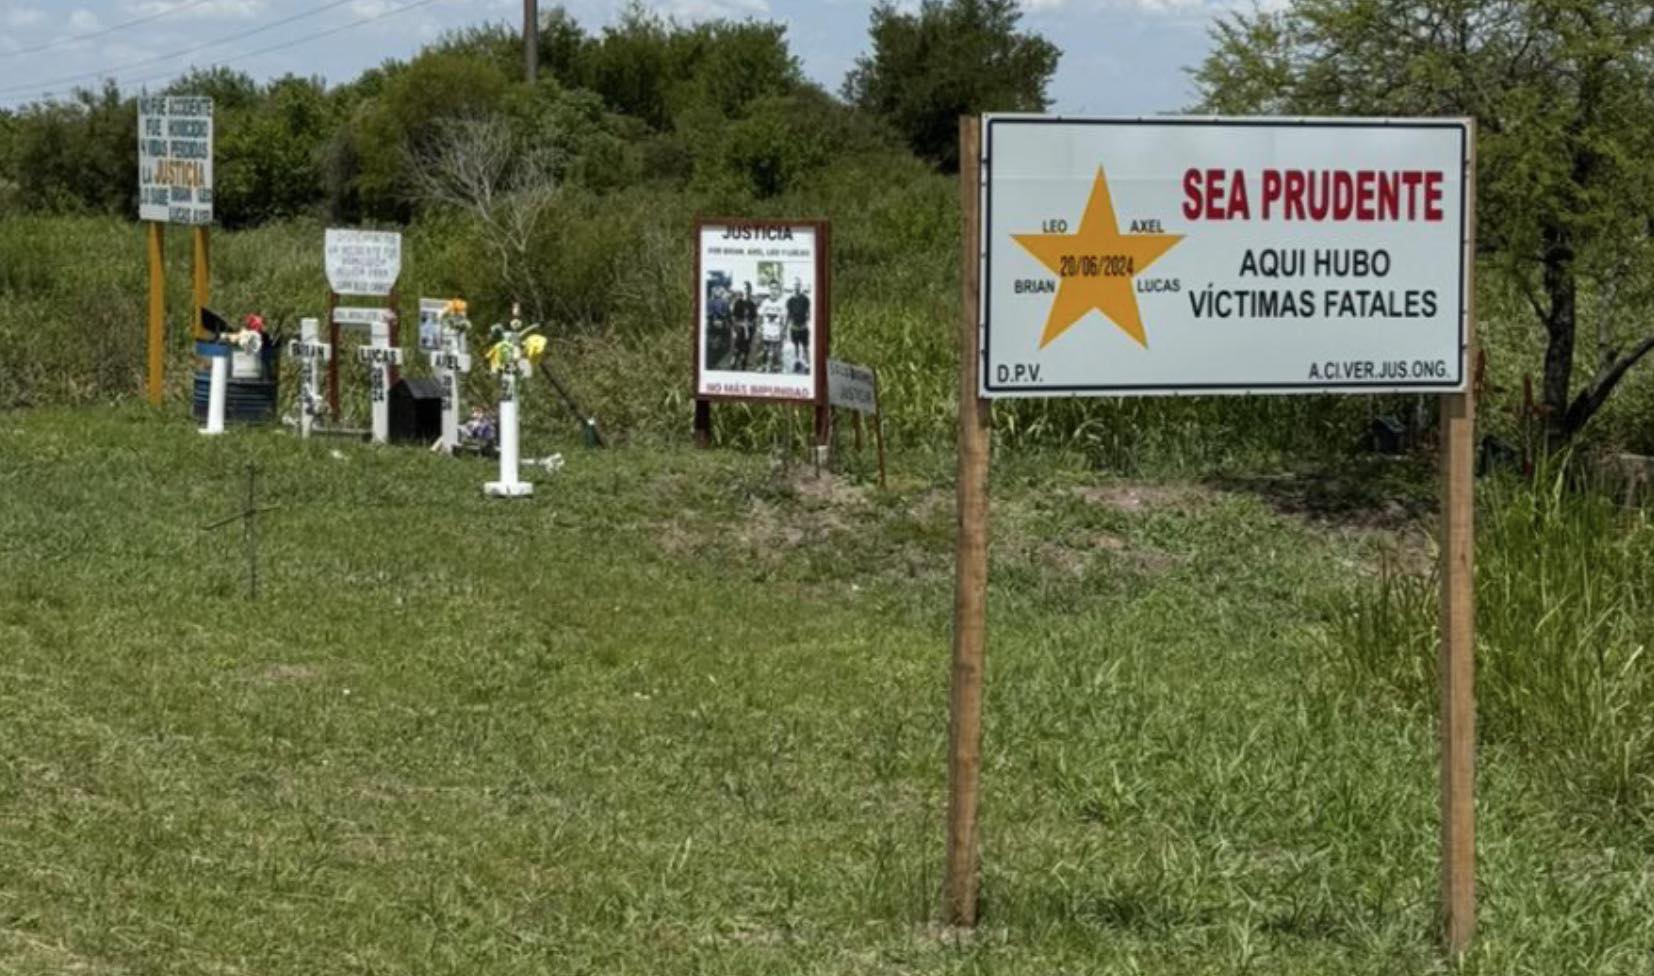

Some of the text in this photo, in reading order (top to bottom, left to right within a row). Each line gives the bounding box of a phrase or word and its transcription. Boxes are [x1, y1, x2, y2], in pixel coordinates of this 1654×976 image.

[154, 160, 206, 186] JUSTICIA
[1181, 167, 1444, 222] SEA PRUDENTE
[722, 225, 794, 241] JUSTICIA
[1043, 220, 1067, 233] LEO
[1130, 220, 1164, 234] AXEL
[1060, 255, 1134, 277] 20/06/2024
[1239, 250, 1391, 277] AQUI HUBO
[1014, 279, 1055, 294] BRIAN
[1137, 278, 1181, 292] LUCAS
[1189, 284, 1437, 318] VÍCTIMAS FATALES
[360, 350, 396, 362] LUCAS
[997, 364, 1043, 382] D.P.V.
[1308, 361, 1450, 380] A.CI.VER.JUS.ONG.
